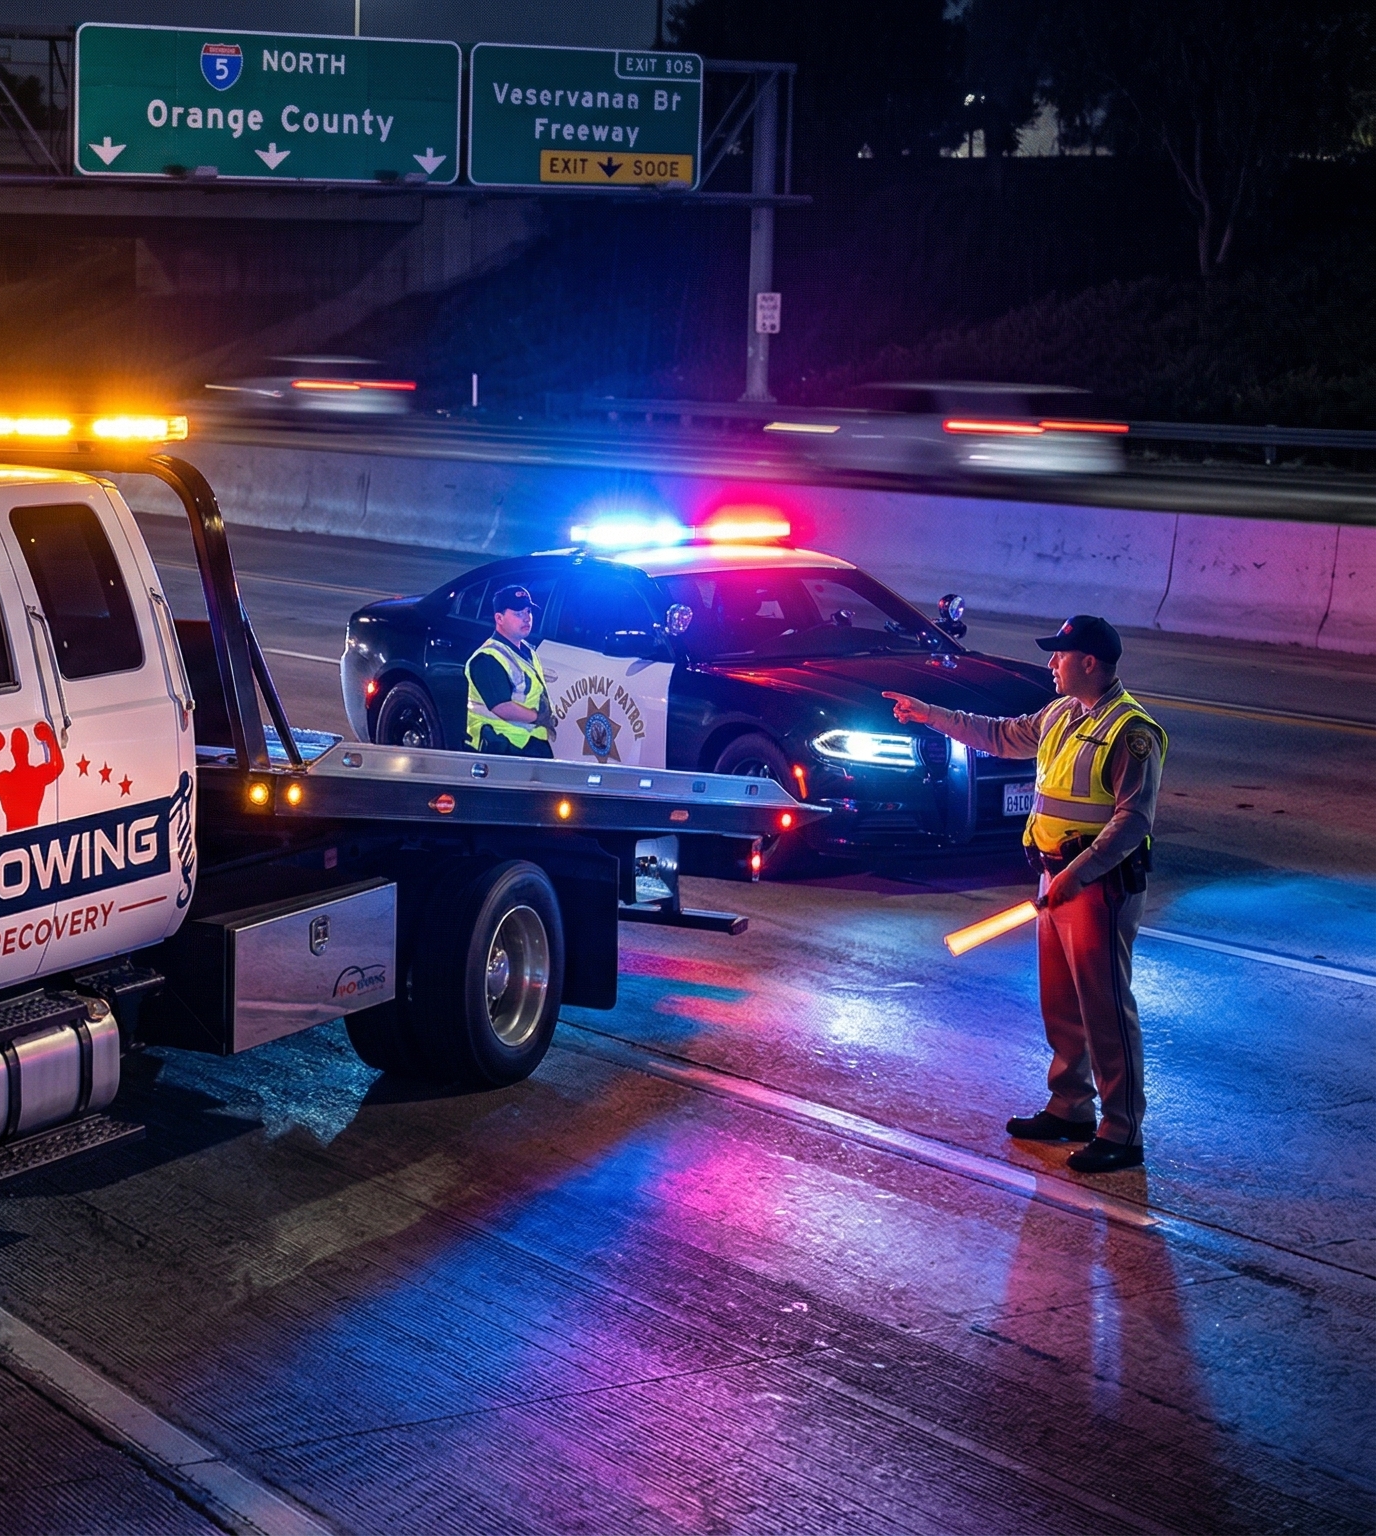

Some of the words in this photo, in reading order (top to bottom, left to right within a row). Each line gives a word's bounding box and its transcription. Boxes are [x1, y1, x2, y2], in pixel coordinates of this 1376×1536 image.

[215, 58, 229, 80] 5
[263, 49, 346, 75] NORTH
[626, 57, 657, 72] EXIT
[147, 99, 263, 138] Orange
[281, 104, 394, 142] County
[535, 118, 639, 148] Freeway
[549, 157, 588, 174] EXIT
[614, 685, 645, 741] PATROL
